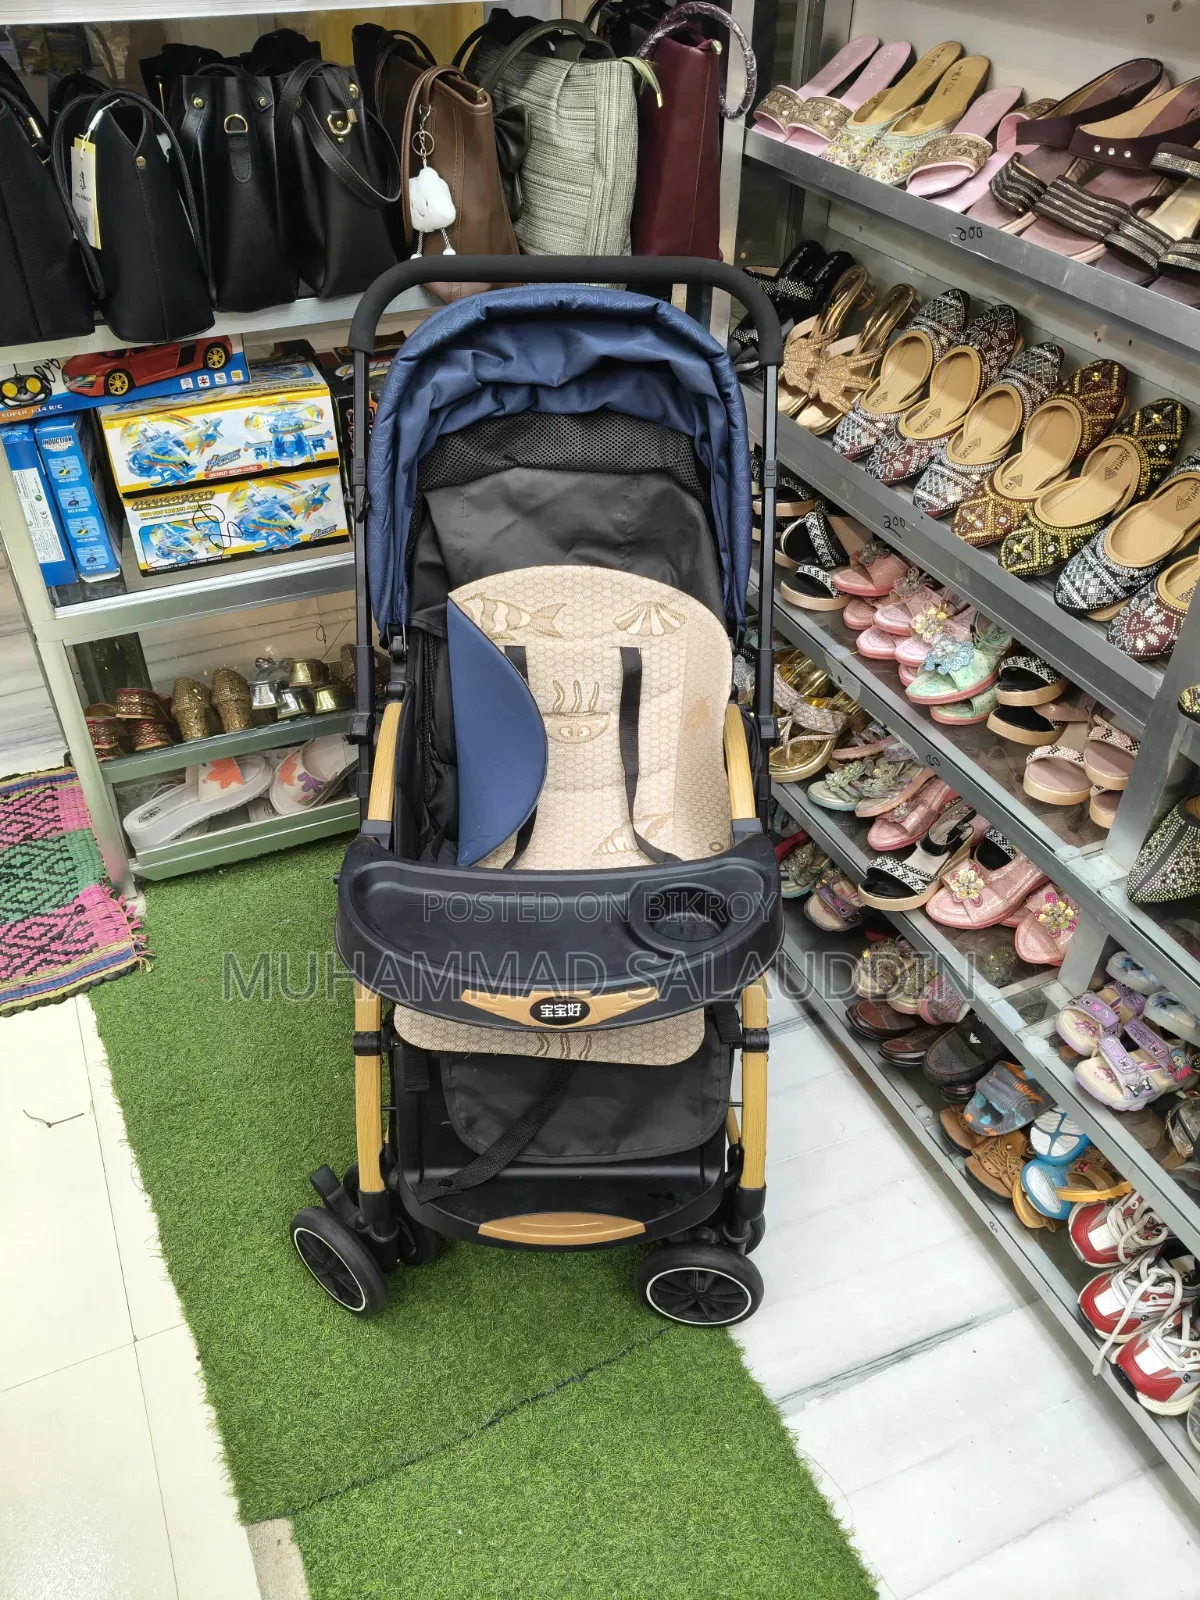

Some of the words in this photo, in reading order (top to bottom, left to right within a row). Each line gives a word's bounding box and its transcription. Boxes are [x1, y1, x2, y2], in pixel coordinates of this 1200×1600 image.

[1, 410, 27, 418] SUPER
[42, 436, 73, 446] INDUCTION
[540, 1003, 582, 1018] 宝宝好
